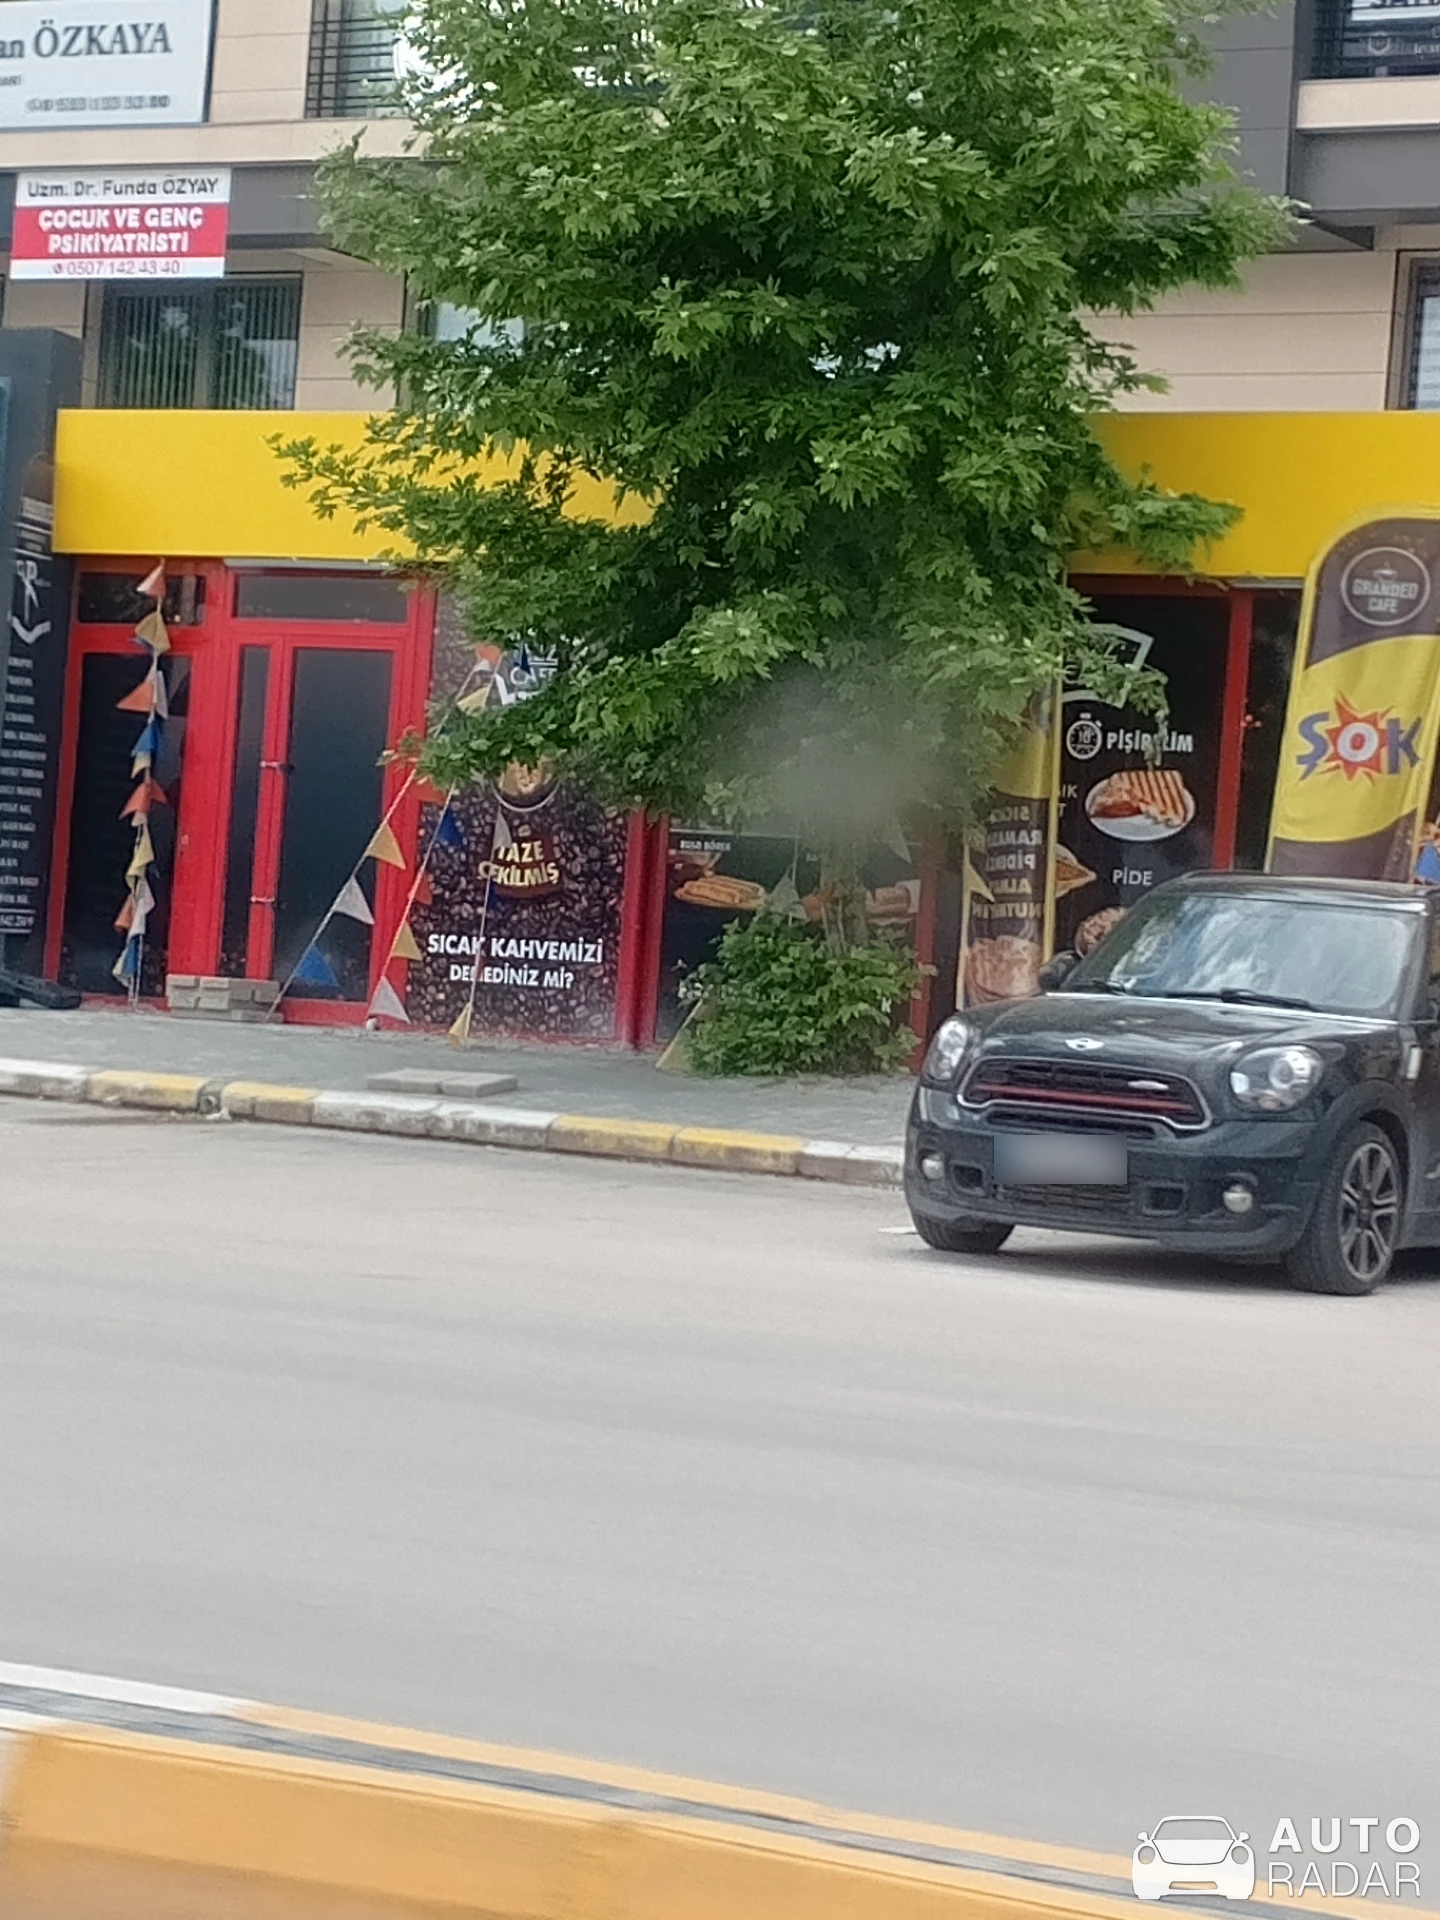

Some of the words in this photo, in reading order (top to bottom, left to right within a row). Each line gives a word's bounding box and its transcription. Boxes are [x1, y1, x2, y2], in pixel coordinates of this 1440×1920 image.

[33, 19, 173, 58] ÖZKAYA
[27, 180, 68, 197] Uzm.
[74, 180, 98, 196] Dr.
[103, 178, 157, 195] Funda
[162, 173, 219, 195] ÖZYAY
[38, 208, 109, 232] ÇOCUK
[114, 207, 140, 229] VE
[144, 206, 204, 230] GENÇ
[47, 231, 190, 254] PSİKİYATRİSTİ
[67, 261, 102, 275] 0507
[109, 260, 135, 275] 142
[138, 260, 158, 275] 43
[159, 260, 181, 274] 40
[1367, 597, 1399, 613] CAFE
[1112, 866, 1153, 885] PİDE
[427, 934, 486, 957] SICAK
[491, 936, 603, 963] KAHVEMİZİ
[543, 966, 575, 989] Mİ?
